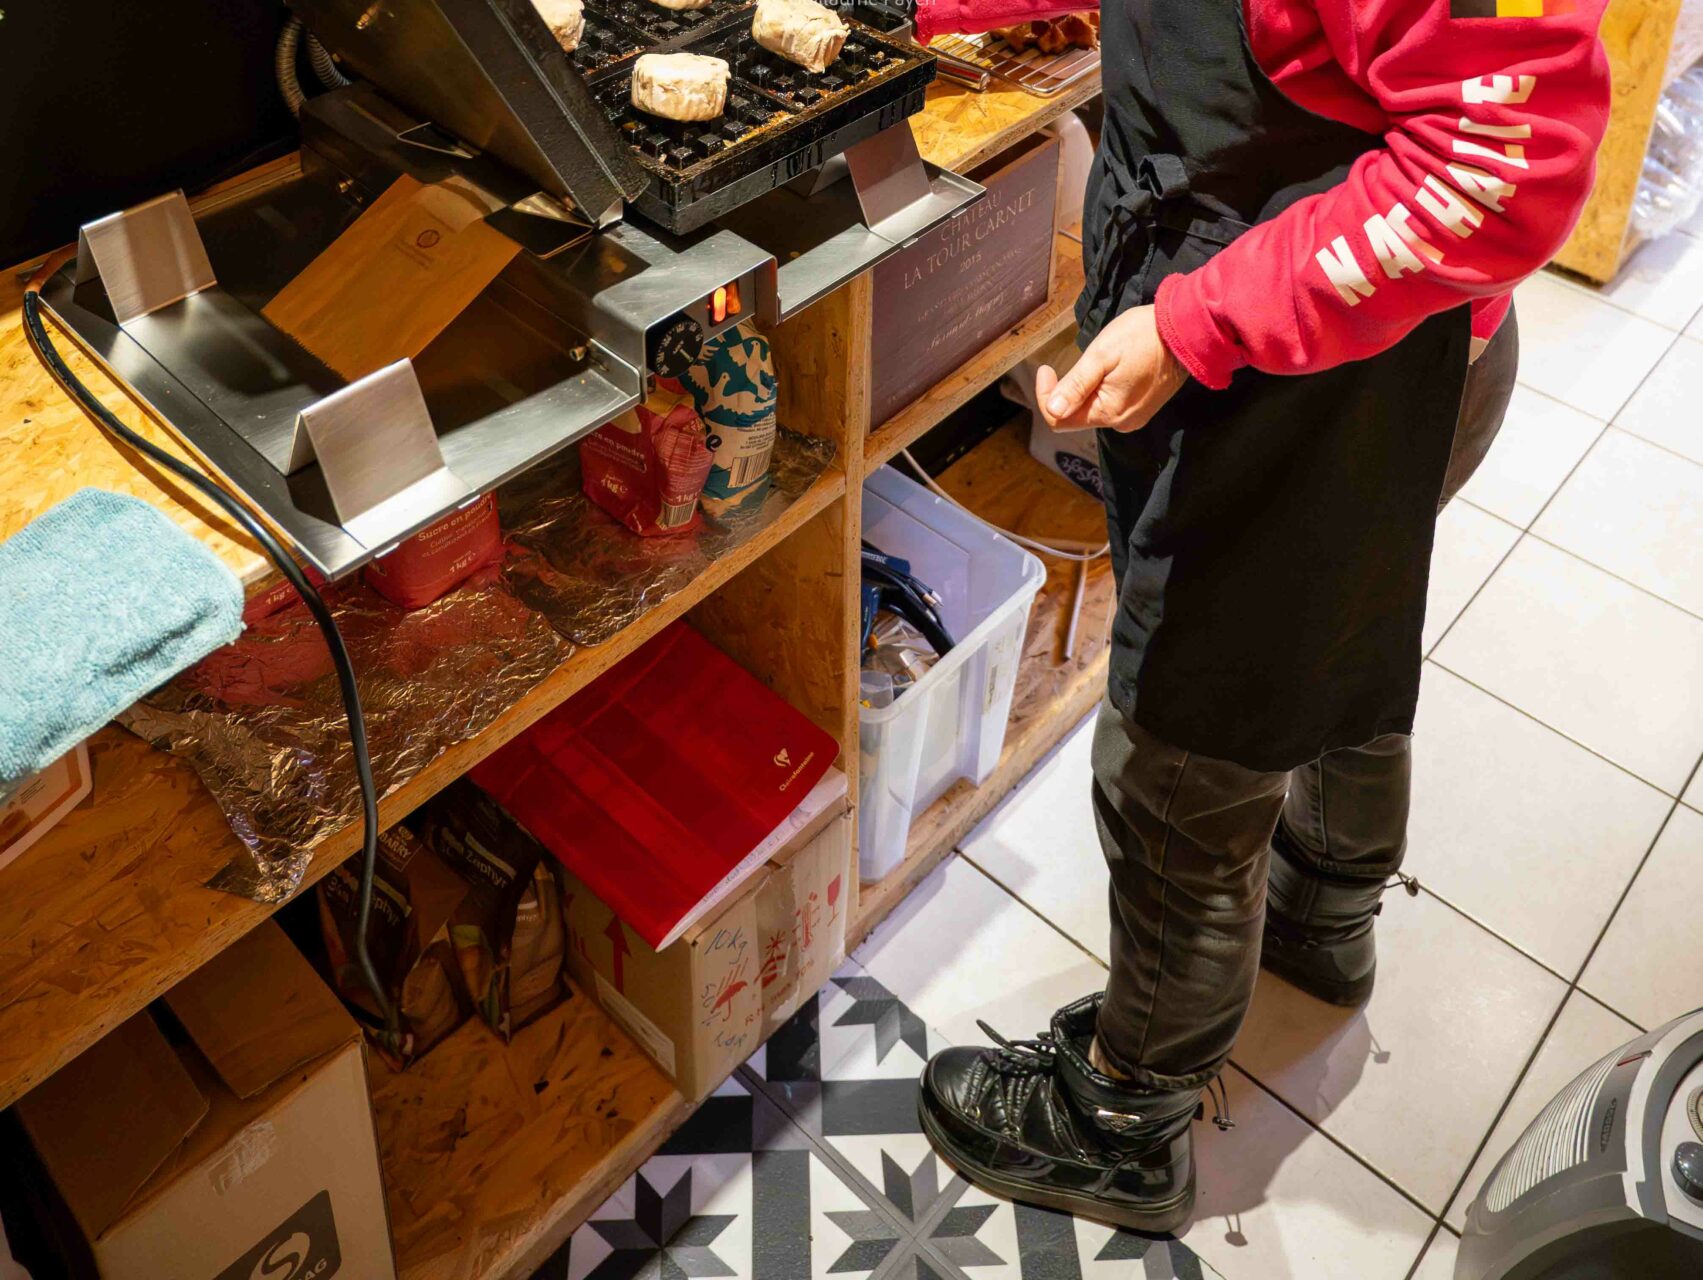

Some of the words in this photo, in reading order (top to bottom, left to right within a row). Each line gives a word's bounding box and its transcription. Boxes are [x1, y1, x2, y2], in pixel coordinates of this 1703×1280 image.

[903, 266, 923, 290] LA
[926, 234, 972, 273] TOUR
[974, 187, 1036, 242] CARNET
[1315, 74, 1537, 307] NATHALIE
